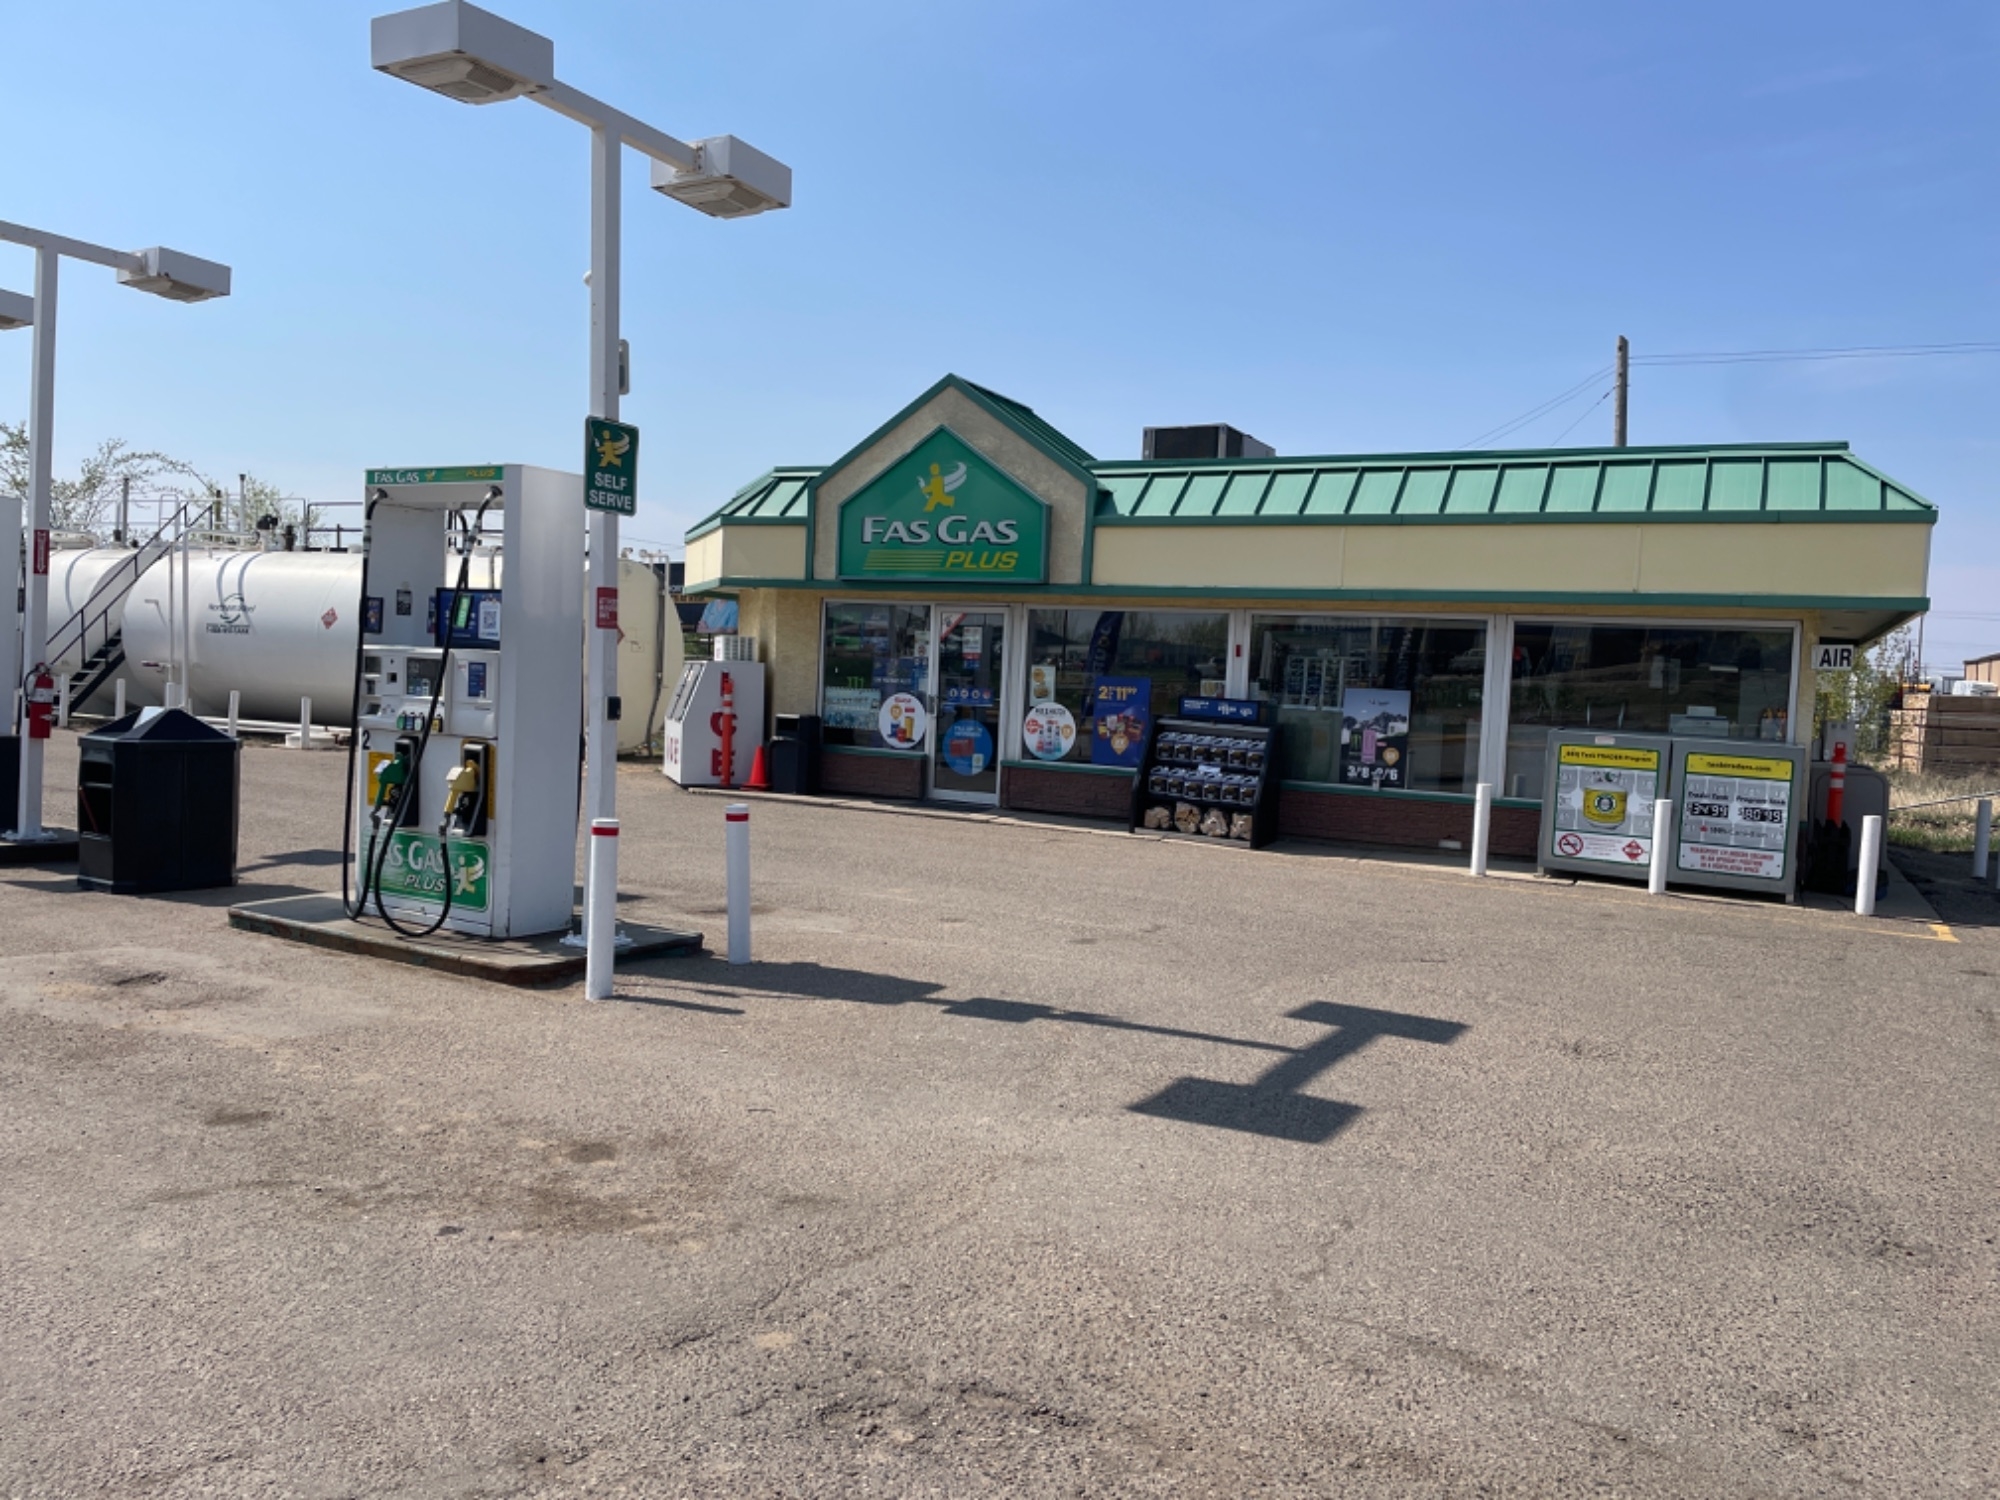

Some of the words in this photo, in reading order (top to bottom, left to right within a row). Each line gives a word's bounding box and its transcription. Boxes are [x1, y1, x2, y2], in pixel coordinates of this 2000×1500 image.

[374, 471, 394, 483] FAS
[396, 470, 420, 483] GAS
[466, 468, 496, 479] PLUS
[594, 471, 628, 490] SELF
[589, 489, 632, 510] SERVE
[861, 516, 932, 544] FAS
[936, 514, 1019, 545] GAS
[945, 551, 1019, 570] PLUS
[1819, 648, 1851, 667] AIR
[362, 729, 371, 751] 2
[404, 874, 446, 892] PLUS
